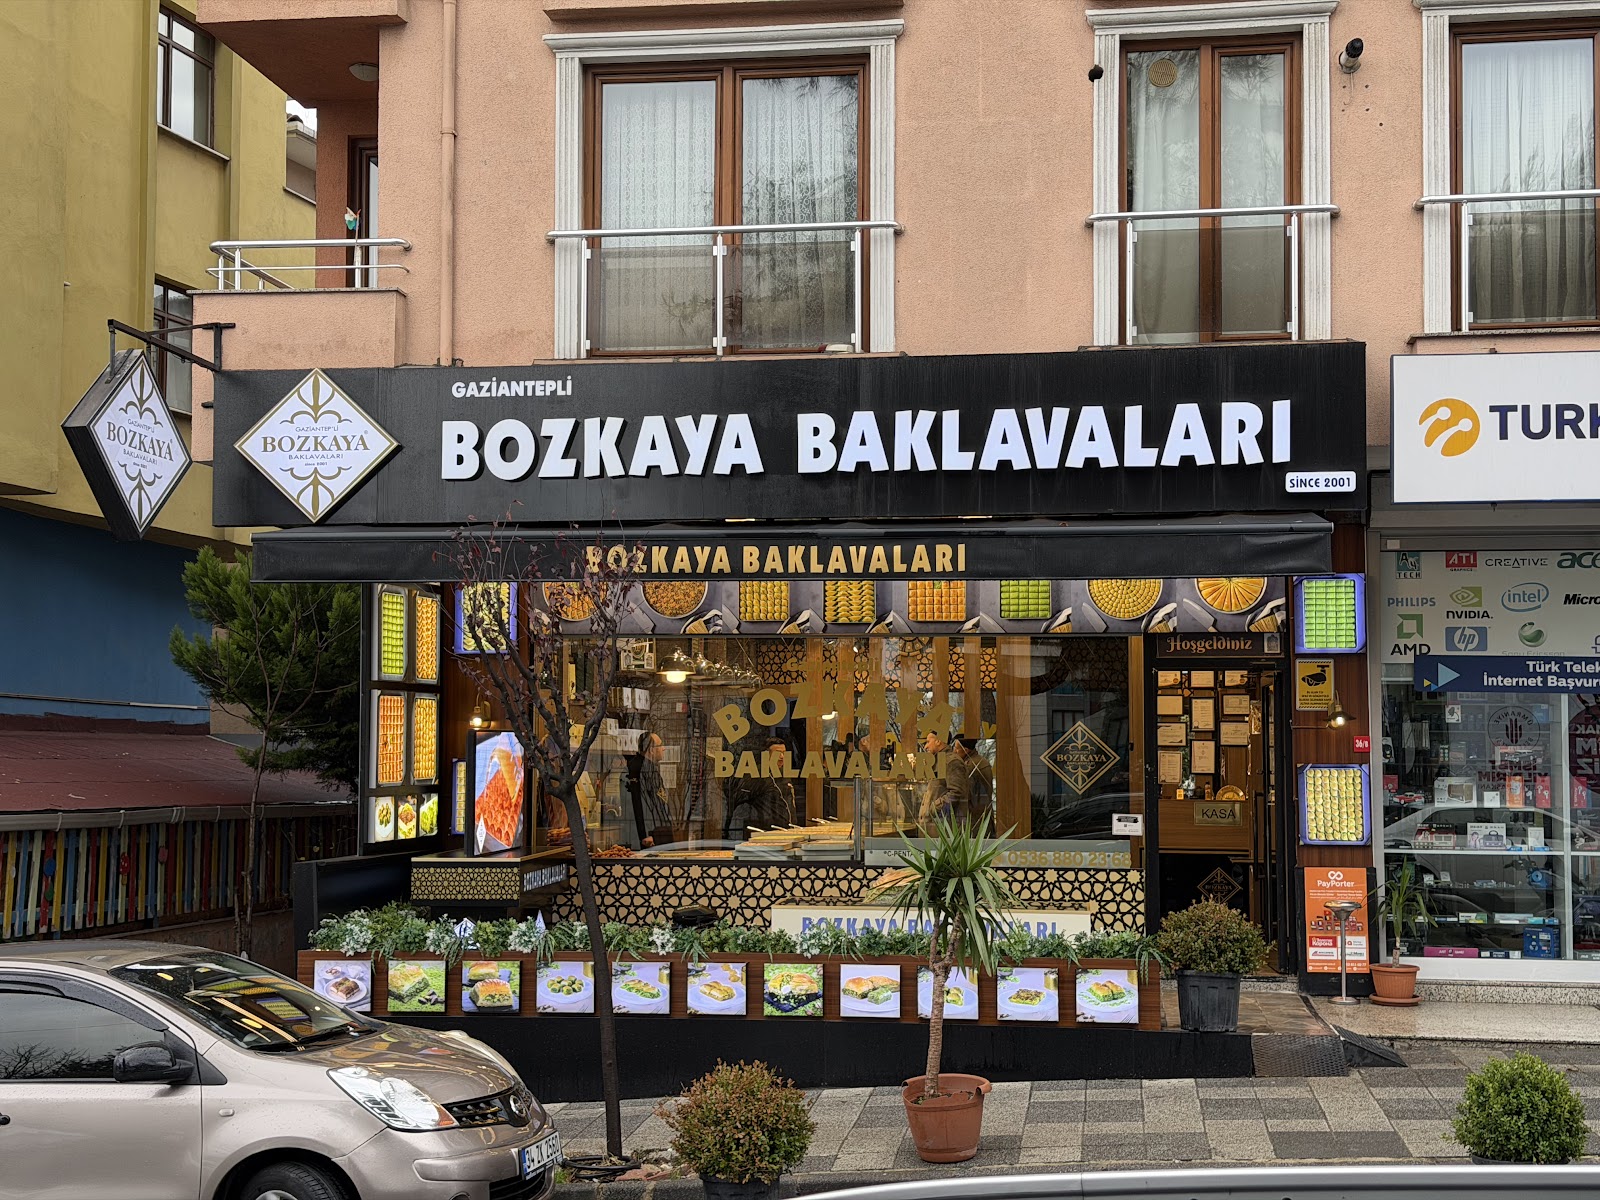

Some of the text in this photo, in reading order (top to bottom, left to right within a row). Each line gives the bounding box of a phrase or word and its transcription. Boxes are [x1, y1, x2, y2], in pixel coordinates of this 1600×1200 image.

[451, 375, 573, 399] GAZİANTEPLİ
[106, 421, 174, 462] BOZKAYA
[261, 434, 370, 453] BOZKAYA
[441, 399, 1291, 481] BOZKAYA BAKLAVALARI
[1324, 476, 1352, 488] 2001
[585, 543, 967, 574] BOZKAYA BAKLAVALARI
[1485, 557, 1549, 568] CREATIVE
[1387, 597, 1436, 607] PHILIPS
[1508, 589, 1541, 603] intel
[1390, 643, 1431, 655] AMD
[1526, 660, 1561, 673] Türk
[1483, 672, 1543, 687] İnternet
[712, 682, 954, 744] BOZKAYA
[714, 750, 948, 779] BAKLAVALARI
[1056, 754, 1107, 762] BOZKAYA
[1201, 808, 1236, 819] KASA
[1007, 850, 1050, 867] 0536
[1052, 850, 1084, 867] 880
[1316, 880, 1355, 888] PayPorter
